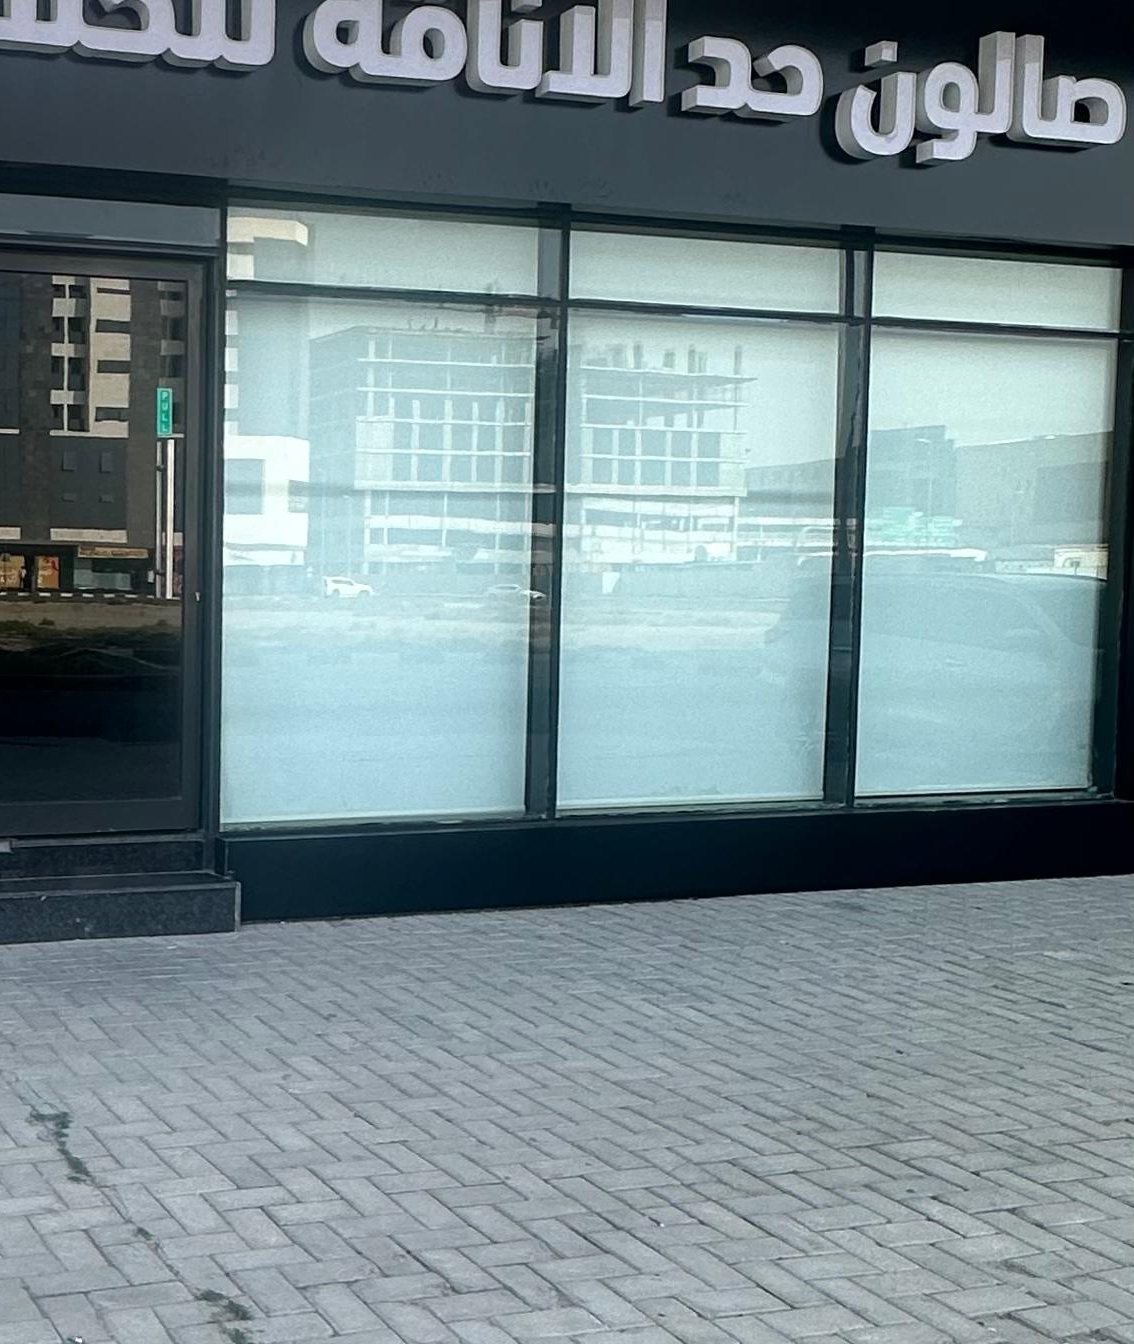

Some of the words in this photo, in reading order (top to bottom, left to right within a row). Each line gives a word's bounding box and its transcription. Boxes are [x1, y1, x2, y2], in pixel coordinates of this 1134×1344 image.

[681, 35, 824, 117] حد
[834, 30, 1128, 166] صالون
[160, 390, 170, 433] PULL
